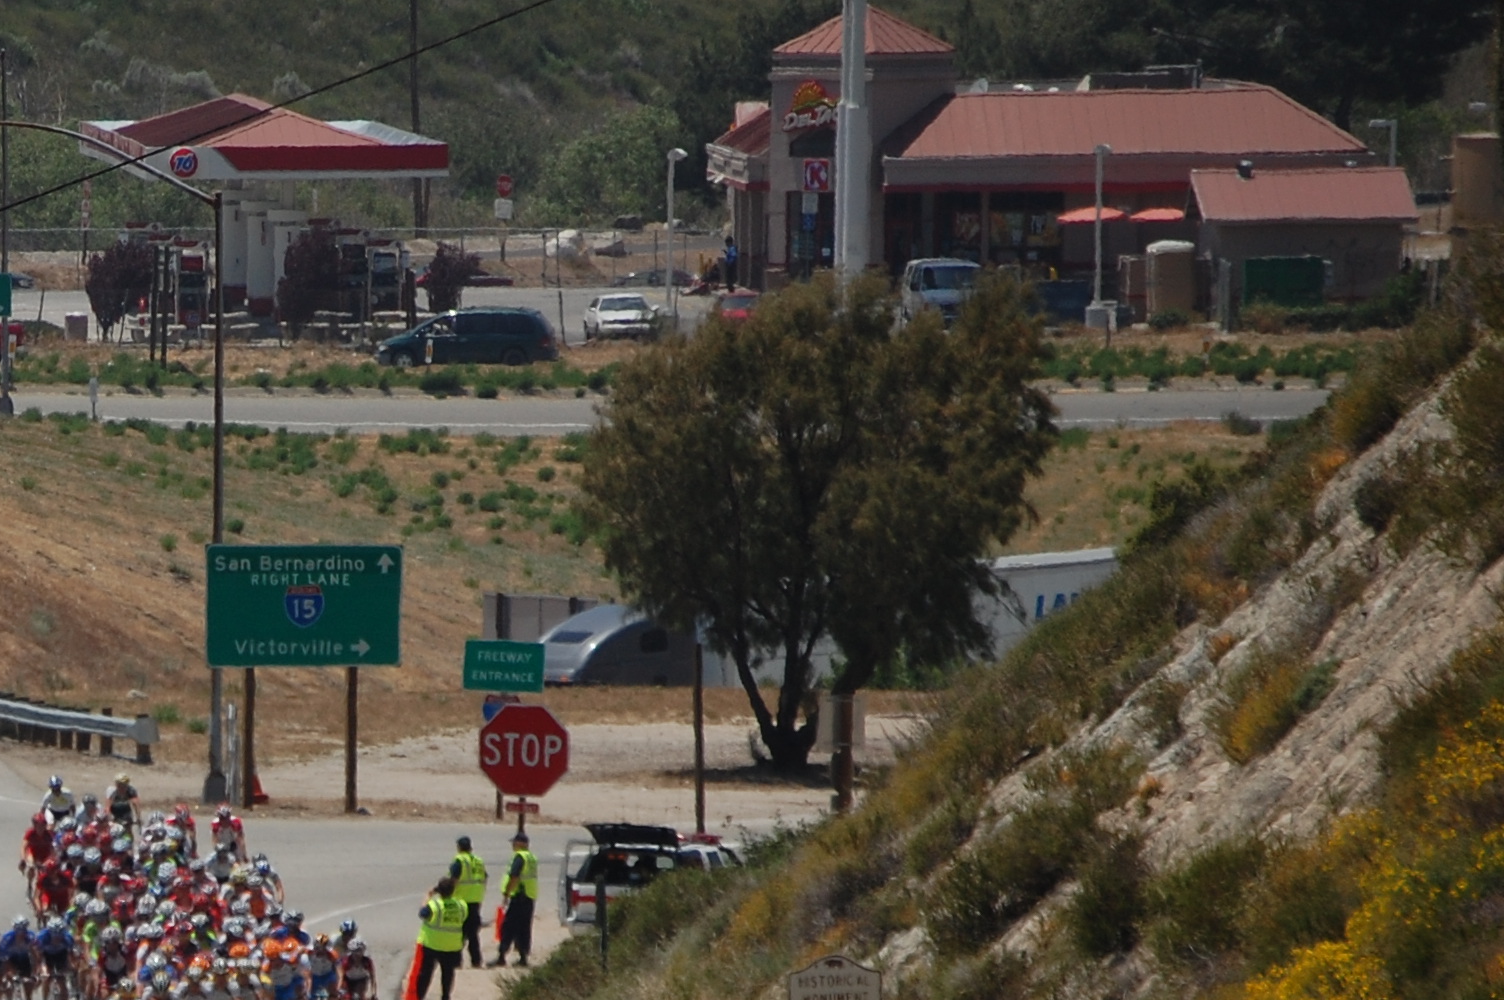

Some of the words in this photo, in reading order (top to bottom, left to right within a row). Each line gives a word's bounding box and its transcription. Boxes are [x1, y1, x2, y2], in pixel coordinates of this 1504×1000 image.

[815, 105, 839, 127] TAC
[173, 153, 195, 173] 76
[215, 556, 251, 572] San
[260, 554, 365, 572] Bernardino
[251, 573, 299, 586] RIGHT
[307, 573, 351, 586] LANE
[293, 599, 316, 619] 15
[234, 638, 344, 656] Victorville
[477, 650, 533, 664] FREEWAY
[471, 670, 535, 683] ENTRANCE
[483, 732, 563, 768] STOP
[798, 975, 871, 988] HISTORICAL
